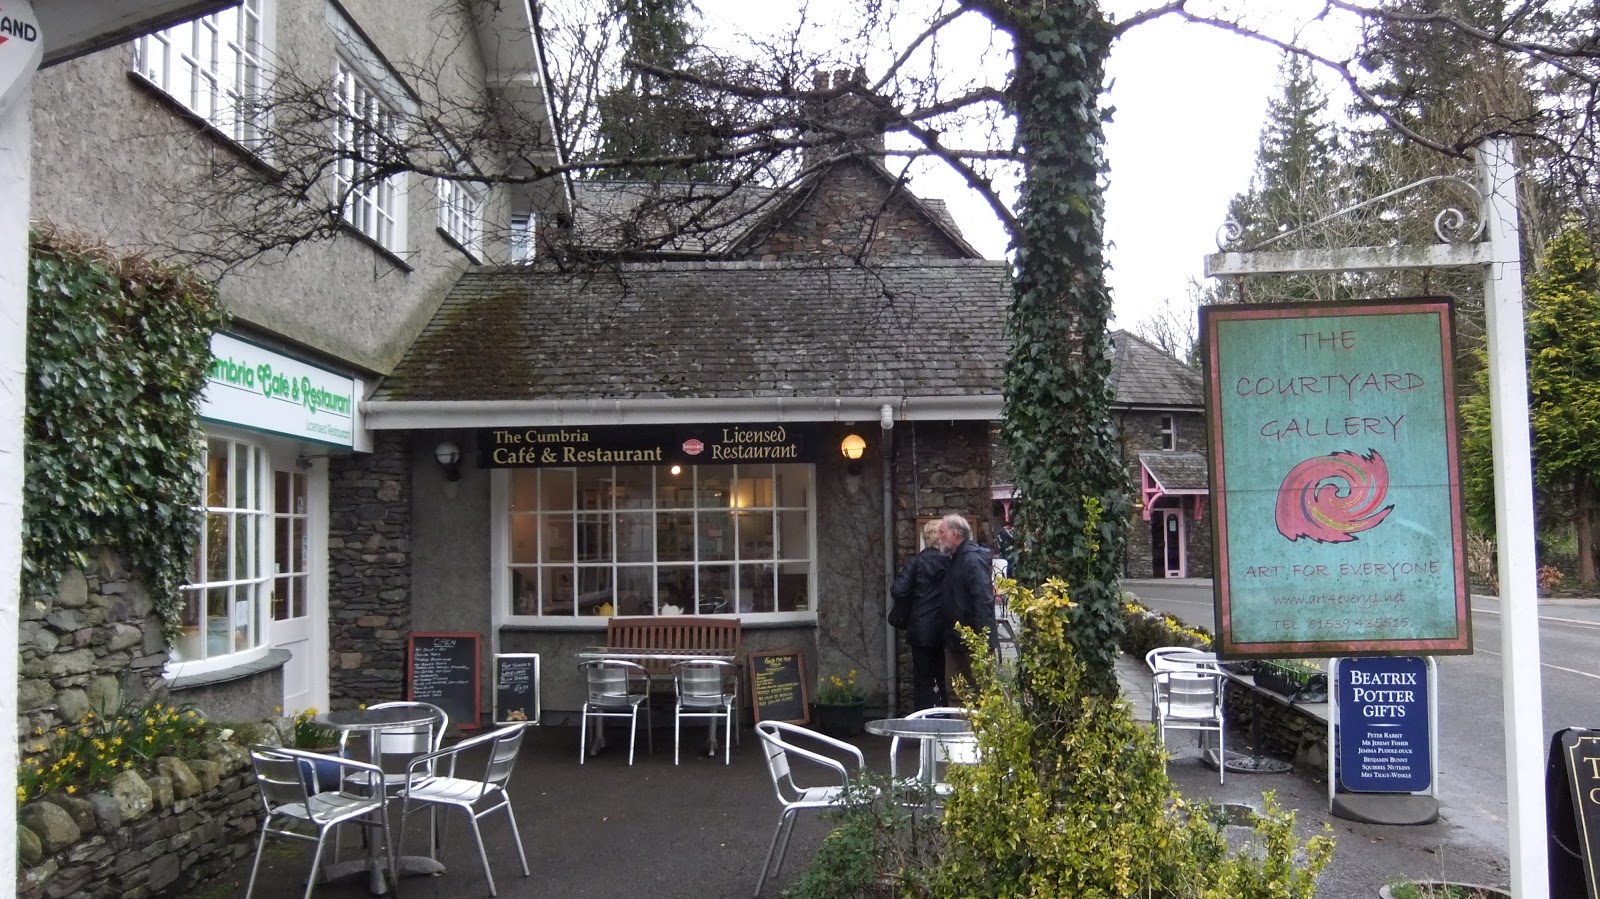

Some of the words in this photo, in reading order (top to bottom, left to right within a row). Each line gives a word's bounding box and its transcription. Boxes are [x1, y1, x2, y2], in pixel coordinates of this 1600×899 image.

[1297, 330, 1357, 350] THE
[1236, 372, 1425, 401] COURTYARD
[292, 377, 300, 401] &
[301, 376, 351, 415] Restaurant
[493, 431, 522, 444] The
[525, 429, 590, 443] Cumbria
[722, 426, 786, 443] Licensed
[1260, 415, 1405, 443] GALLERY
[493, 447, 536, 464] Café
[541, 447, 557, 463] &
[562, 446, 663, 463] Restaurant
[711, 444, 798, 460] Restaurant
[1243, 565, 1285, 580] ART
[1292, 564, 1330, 578] FOR
[1340, 560, 1441, 583] EVERYONE
[1272, 619, 1300, 631] TEL
[1308, 618, 1351, 633] 01539
[1350, 670, 1417, 685] BEATRIX
[1353, 687, 1415, 702] POTTER
[1362, 705, 1406, 717] GIFTS
